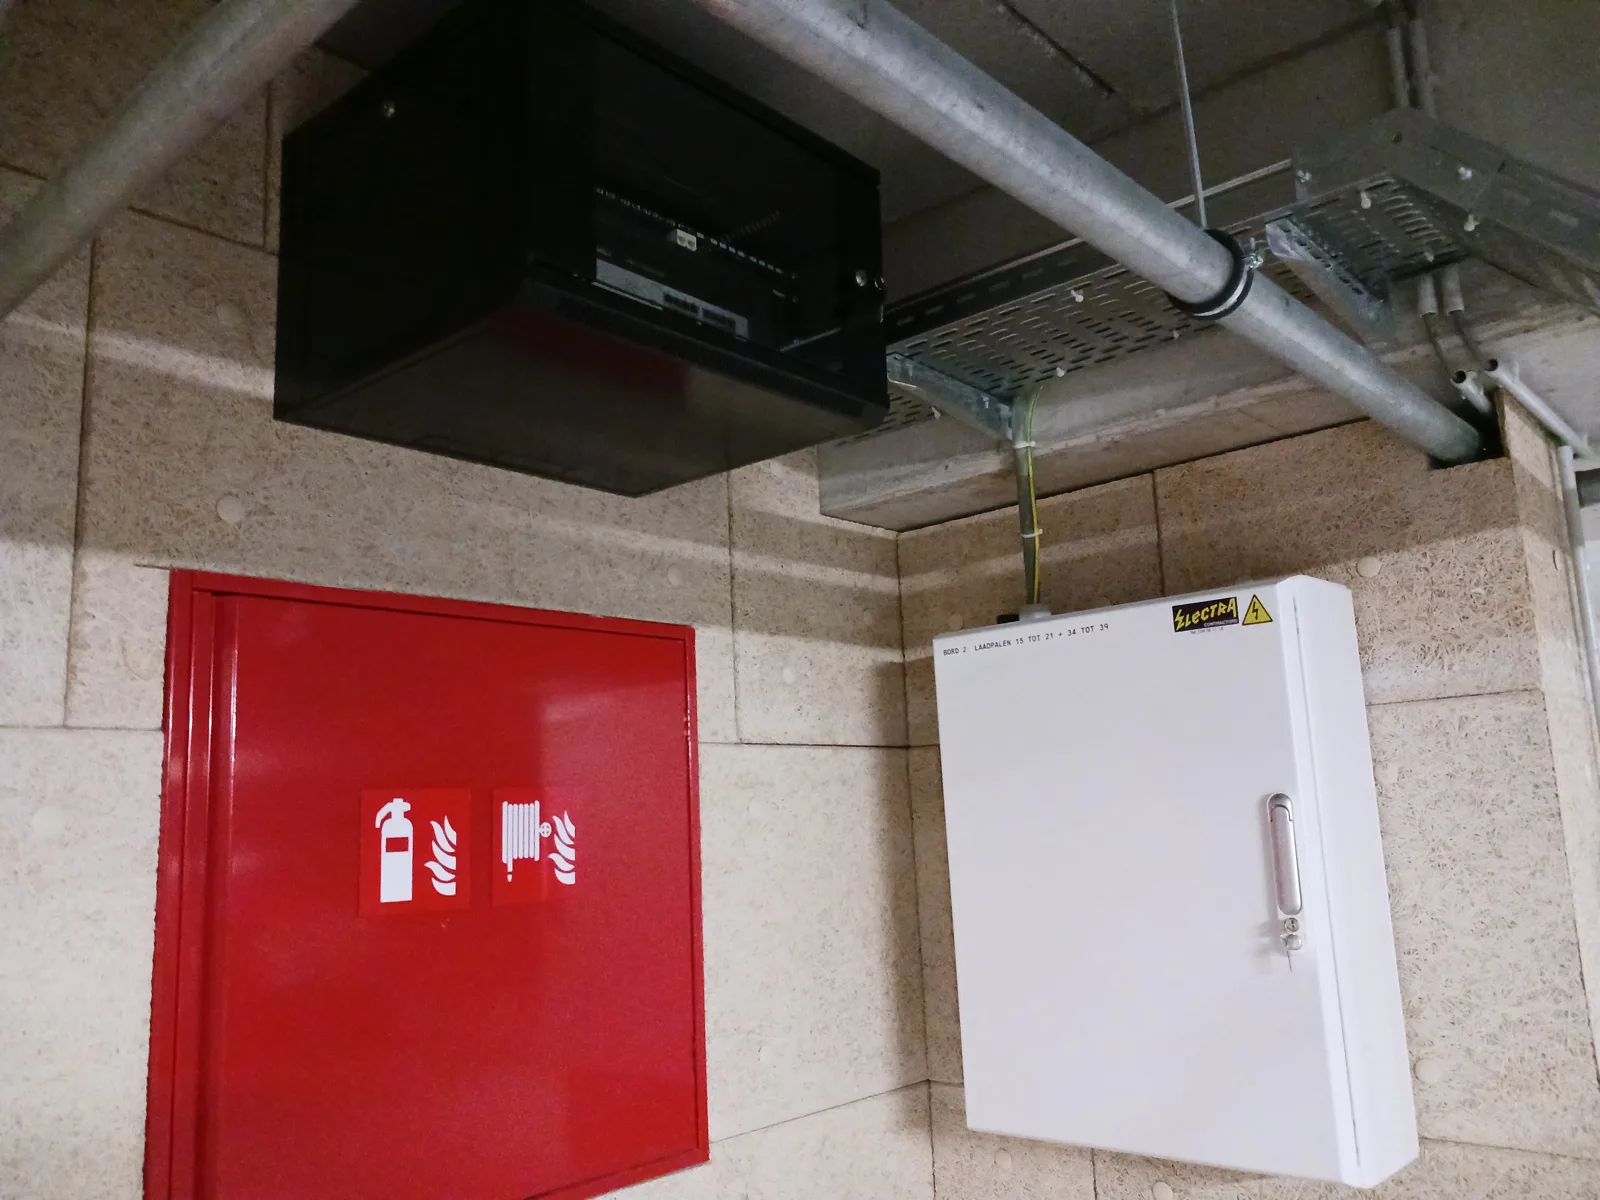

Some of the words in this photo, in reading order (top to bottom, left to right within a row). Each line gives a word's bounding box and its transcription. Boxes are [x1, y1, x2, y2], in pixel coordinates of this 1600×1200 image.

[943, 647, 959, 656] BORD
[974, 639, 1011, 651] LAADPALEN
[1016, 637, 1024, 645] 15
[1028, 634, 1040, 642] TOT
[1045, 632, 1053, 640] 21
[1067, 628, 1076, 636] 34
[1081, 625, 1094, 634] TOT
[1099, 623, 1108, 631] 39
